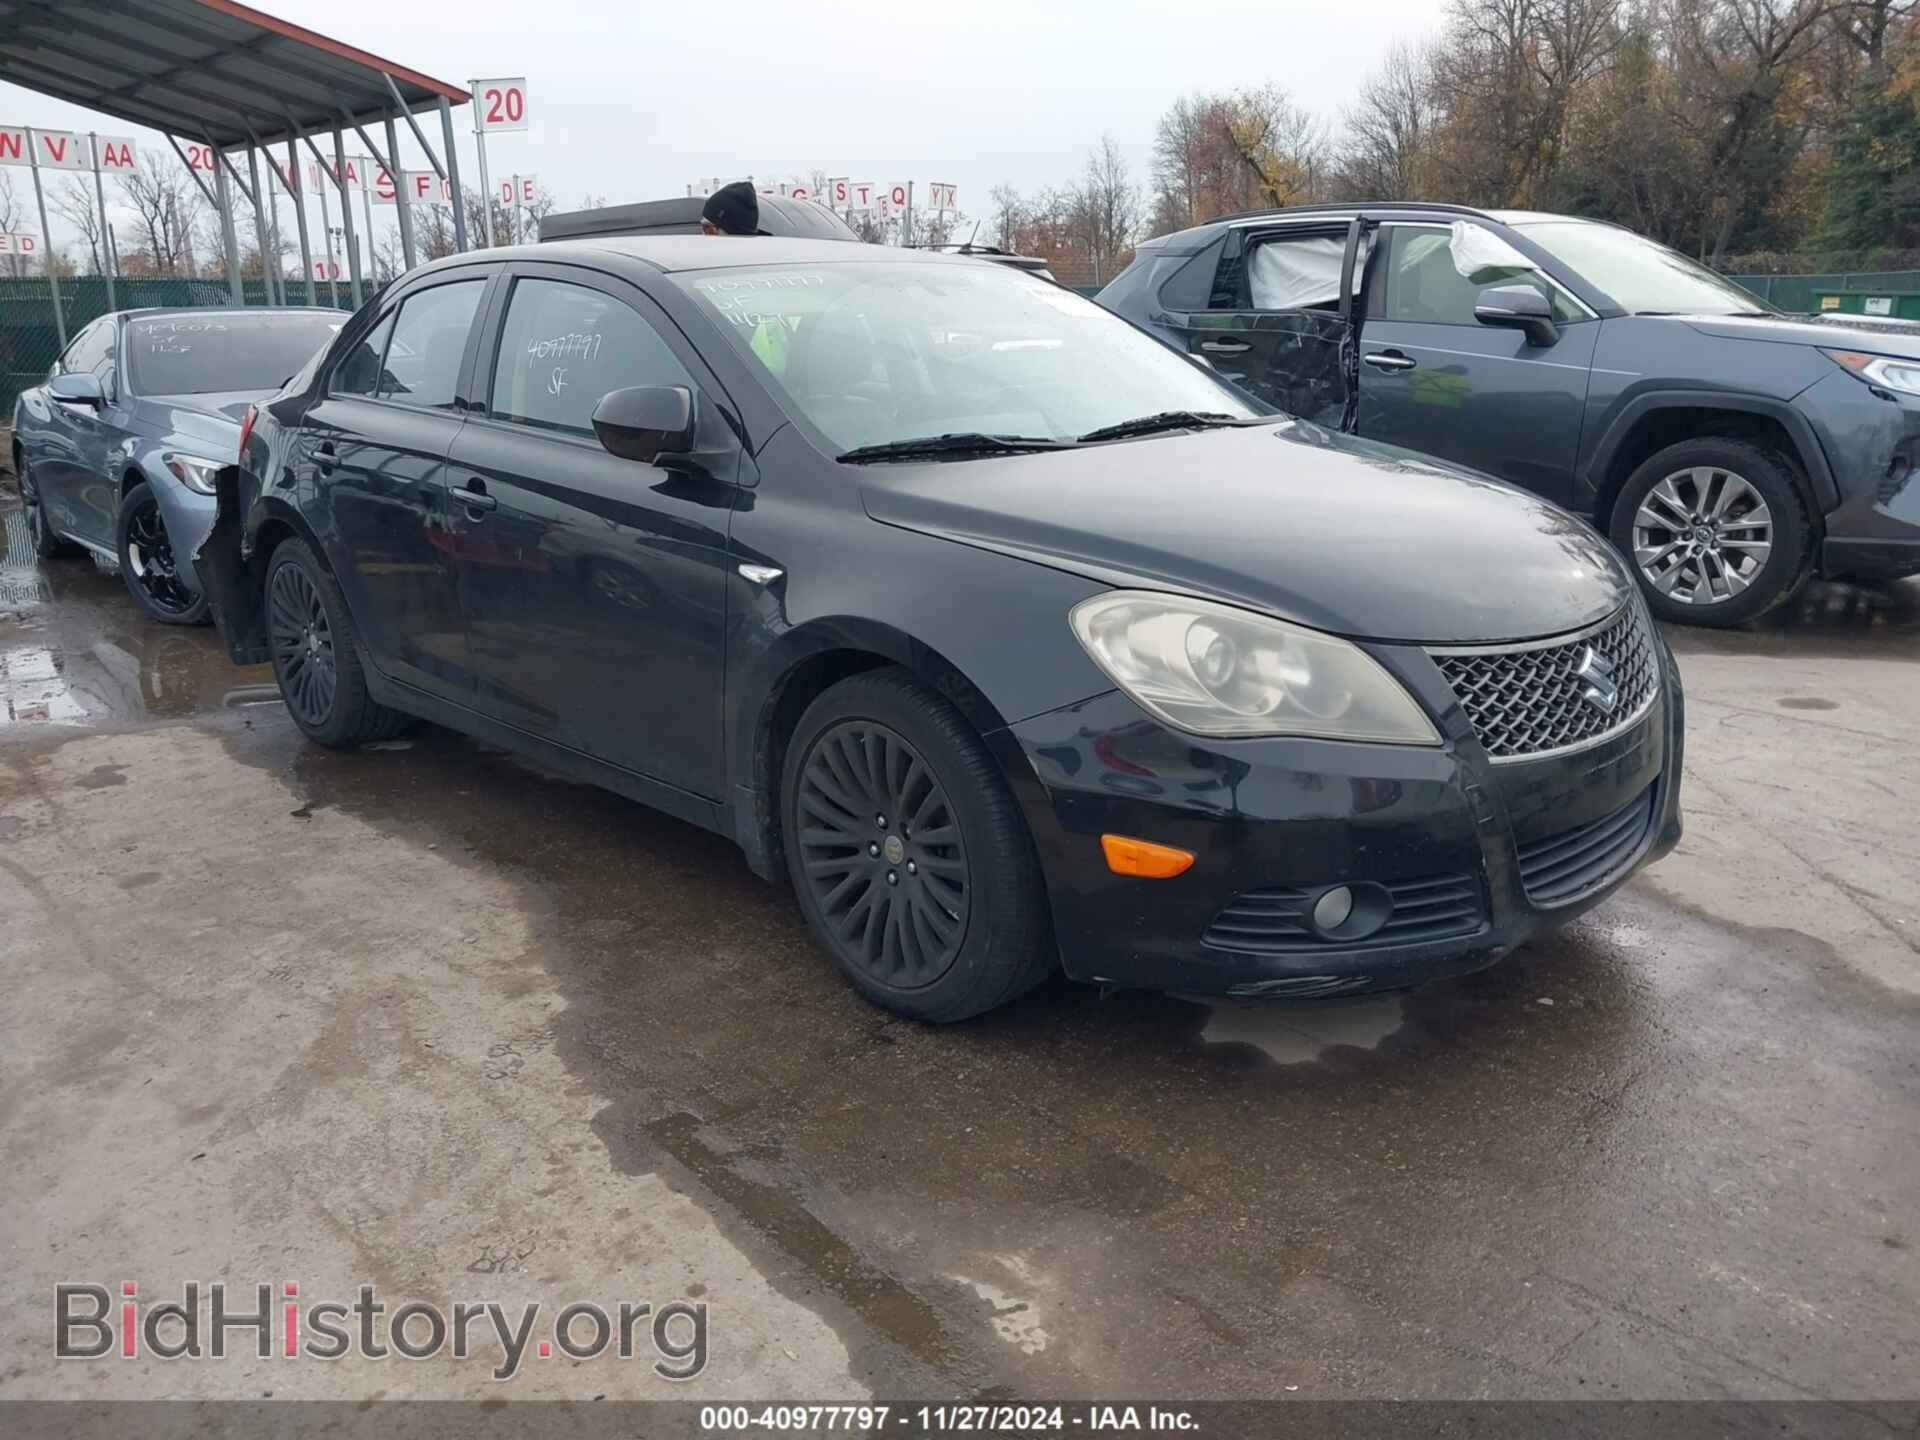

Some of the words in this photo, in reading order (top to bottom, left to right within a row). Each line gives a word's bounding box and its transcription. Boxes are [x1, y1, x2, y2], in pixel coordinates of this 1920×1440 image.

[484, 87, 524, 123] 20
[44, 135, 66, 162] V
[103, 142, 134, 167] AA
[188, 145, 217, 171] 20
[415, 175, 431, 198] F
[502, 182, 513, 203] D
[523, 180, 534, 201] E
[835, 182, 846, 201] S
[856, 187, 870, 205] T
[891, 186, 905, 206] Q
[22, 237, 35, 251] D
